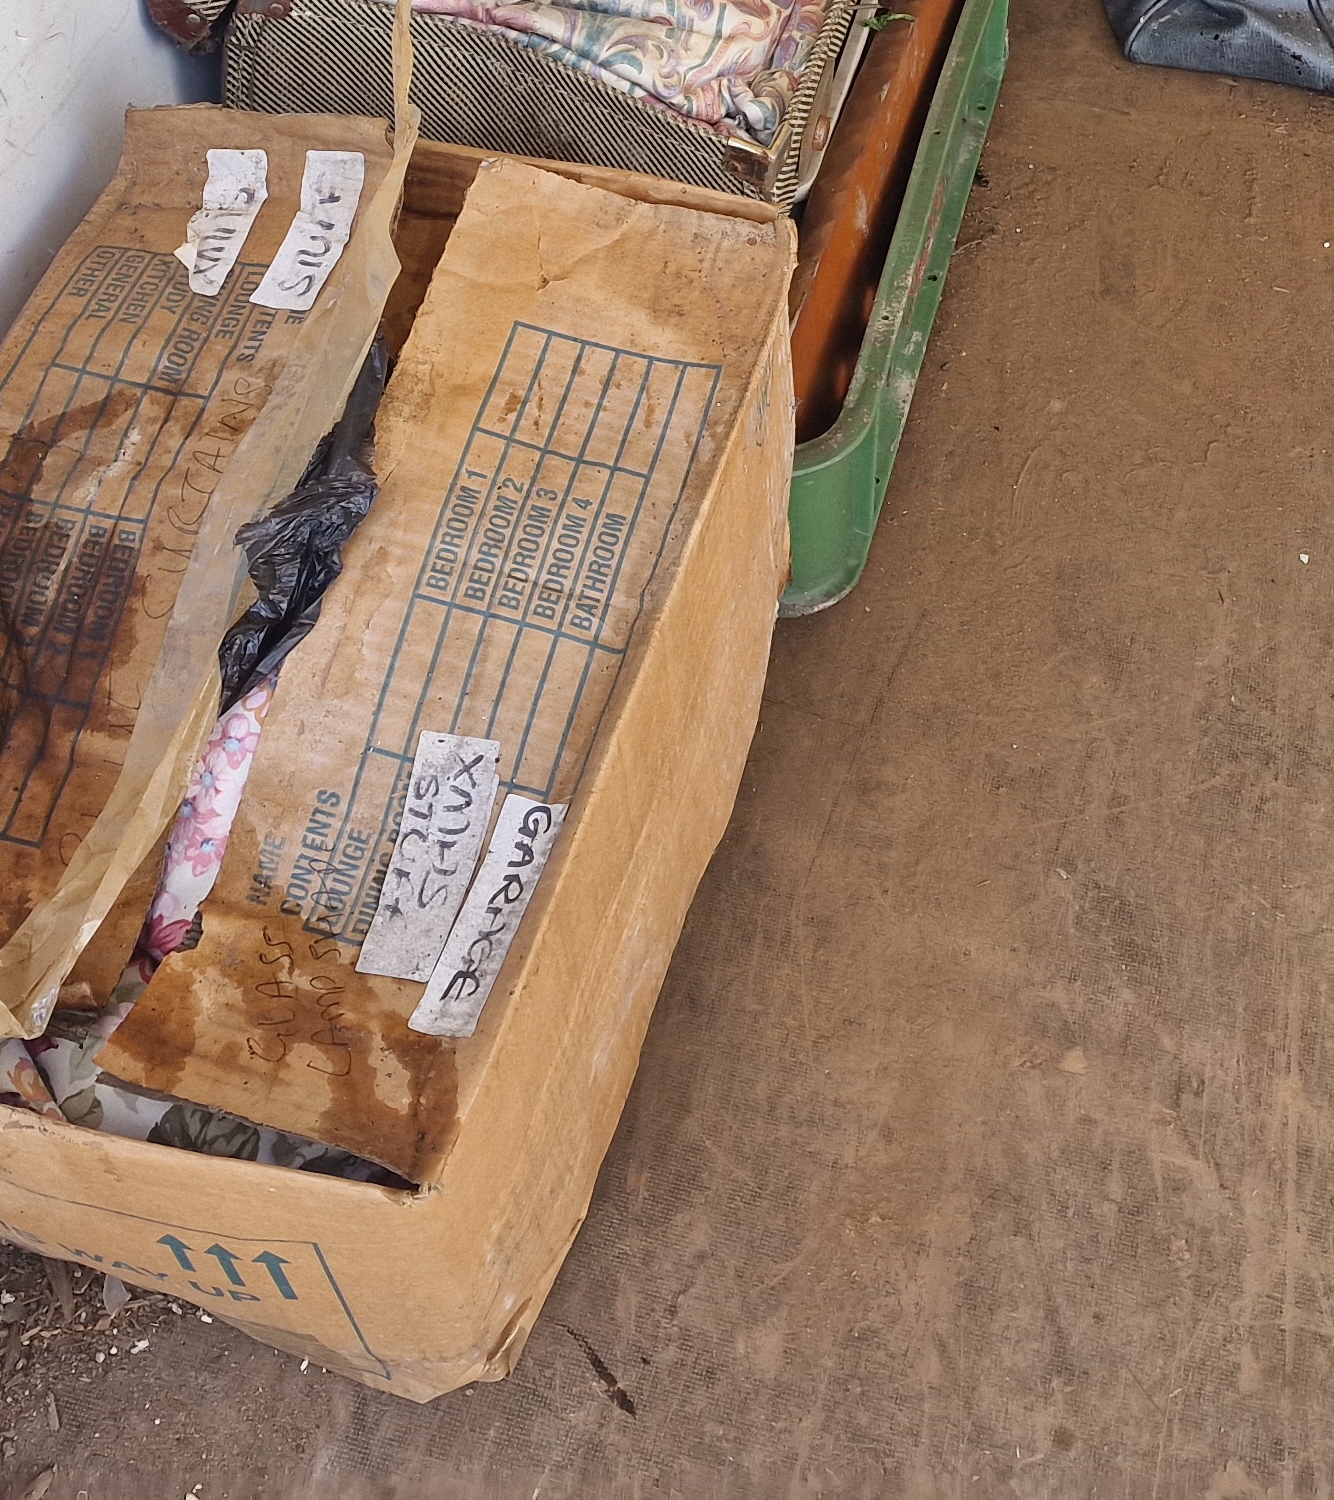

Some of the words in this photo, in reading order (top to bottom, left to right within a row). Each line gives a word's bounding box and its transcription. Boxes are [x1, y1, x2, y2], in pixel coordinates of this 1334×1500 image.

[68, 250, 115, 297] OTHER
[85, 254, 144, 321] GENERAL
[119, 258, 174, 324] KITCHEN
[161, 275, 193, 315] UDY
[215, 269, 263, 341] LOUNGE
[165, 326, 202, 385] ROOM
[236, 311, 278, 364] TENTS
[425, 485, 482, 592] BEDROOM
[465, 467, 488, 480] 1
[463, 495, 518, 601] BEDROOM
[502, 477, 525, 494] 2
[497, 504, 552, 611] BEDROOM
[536, 488, 558, 501] 3
[533, 513, 588, 621] BEDROOM
[572, 497, 593, 511] 4
[569, 512, 626, 632] BATHROOM
[54, 524, 107, 634] BEDROOM
[81, 529, 136, 642] BEDROOM
[246, 835, 286, 907] NAME
[279, 789, 341, 916] CONTENTS
[320, 828, 371, 928] LOUNGE
[56, 1242, 169, 1282] WAY
[190, 1280, 261, 1304] UP
